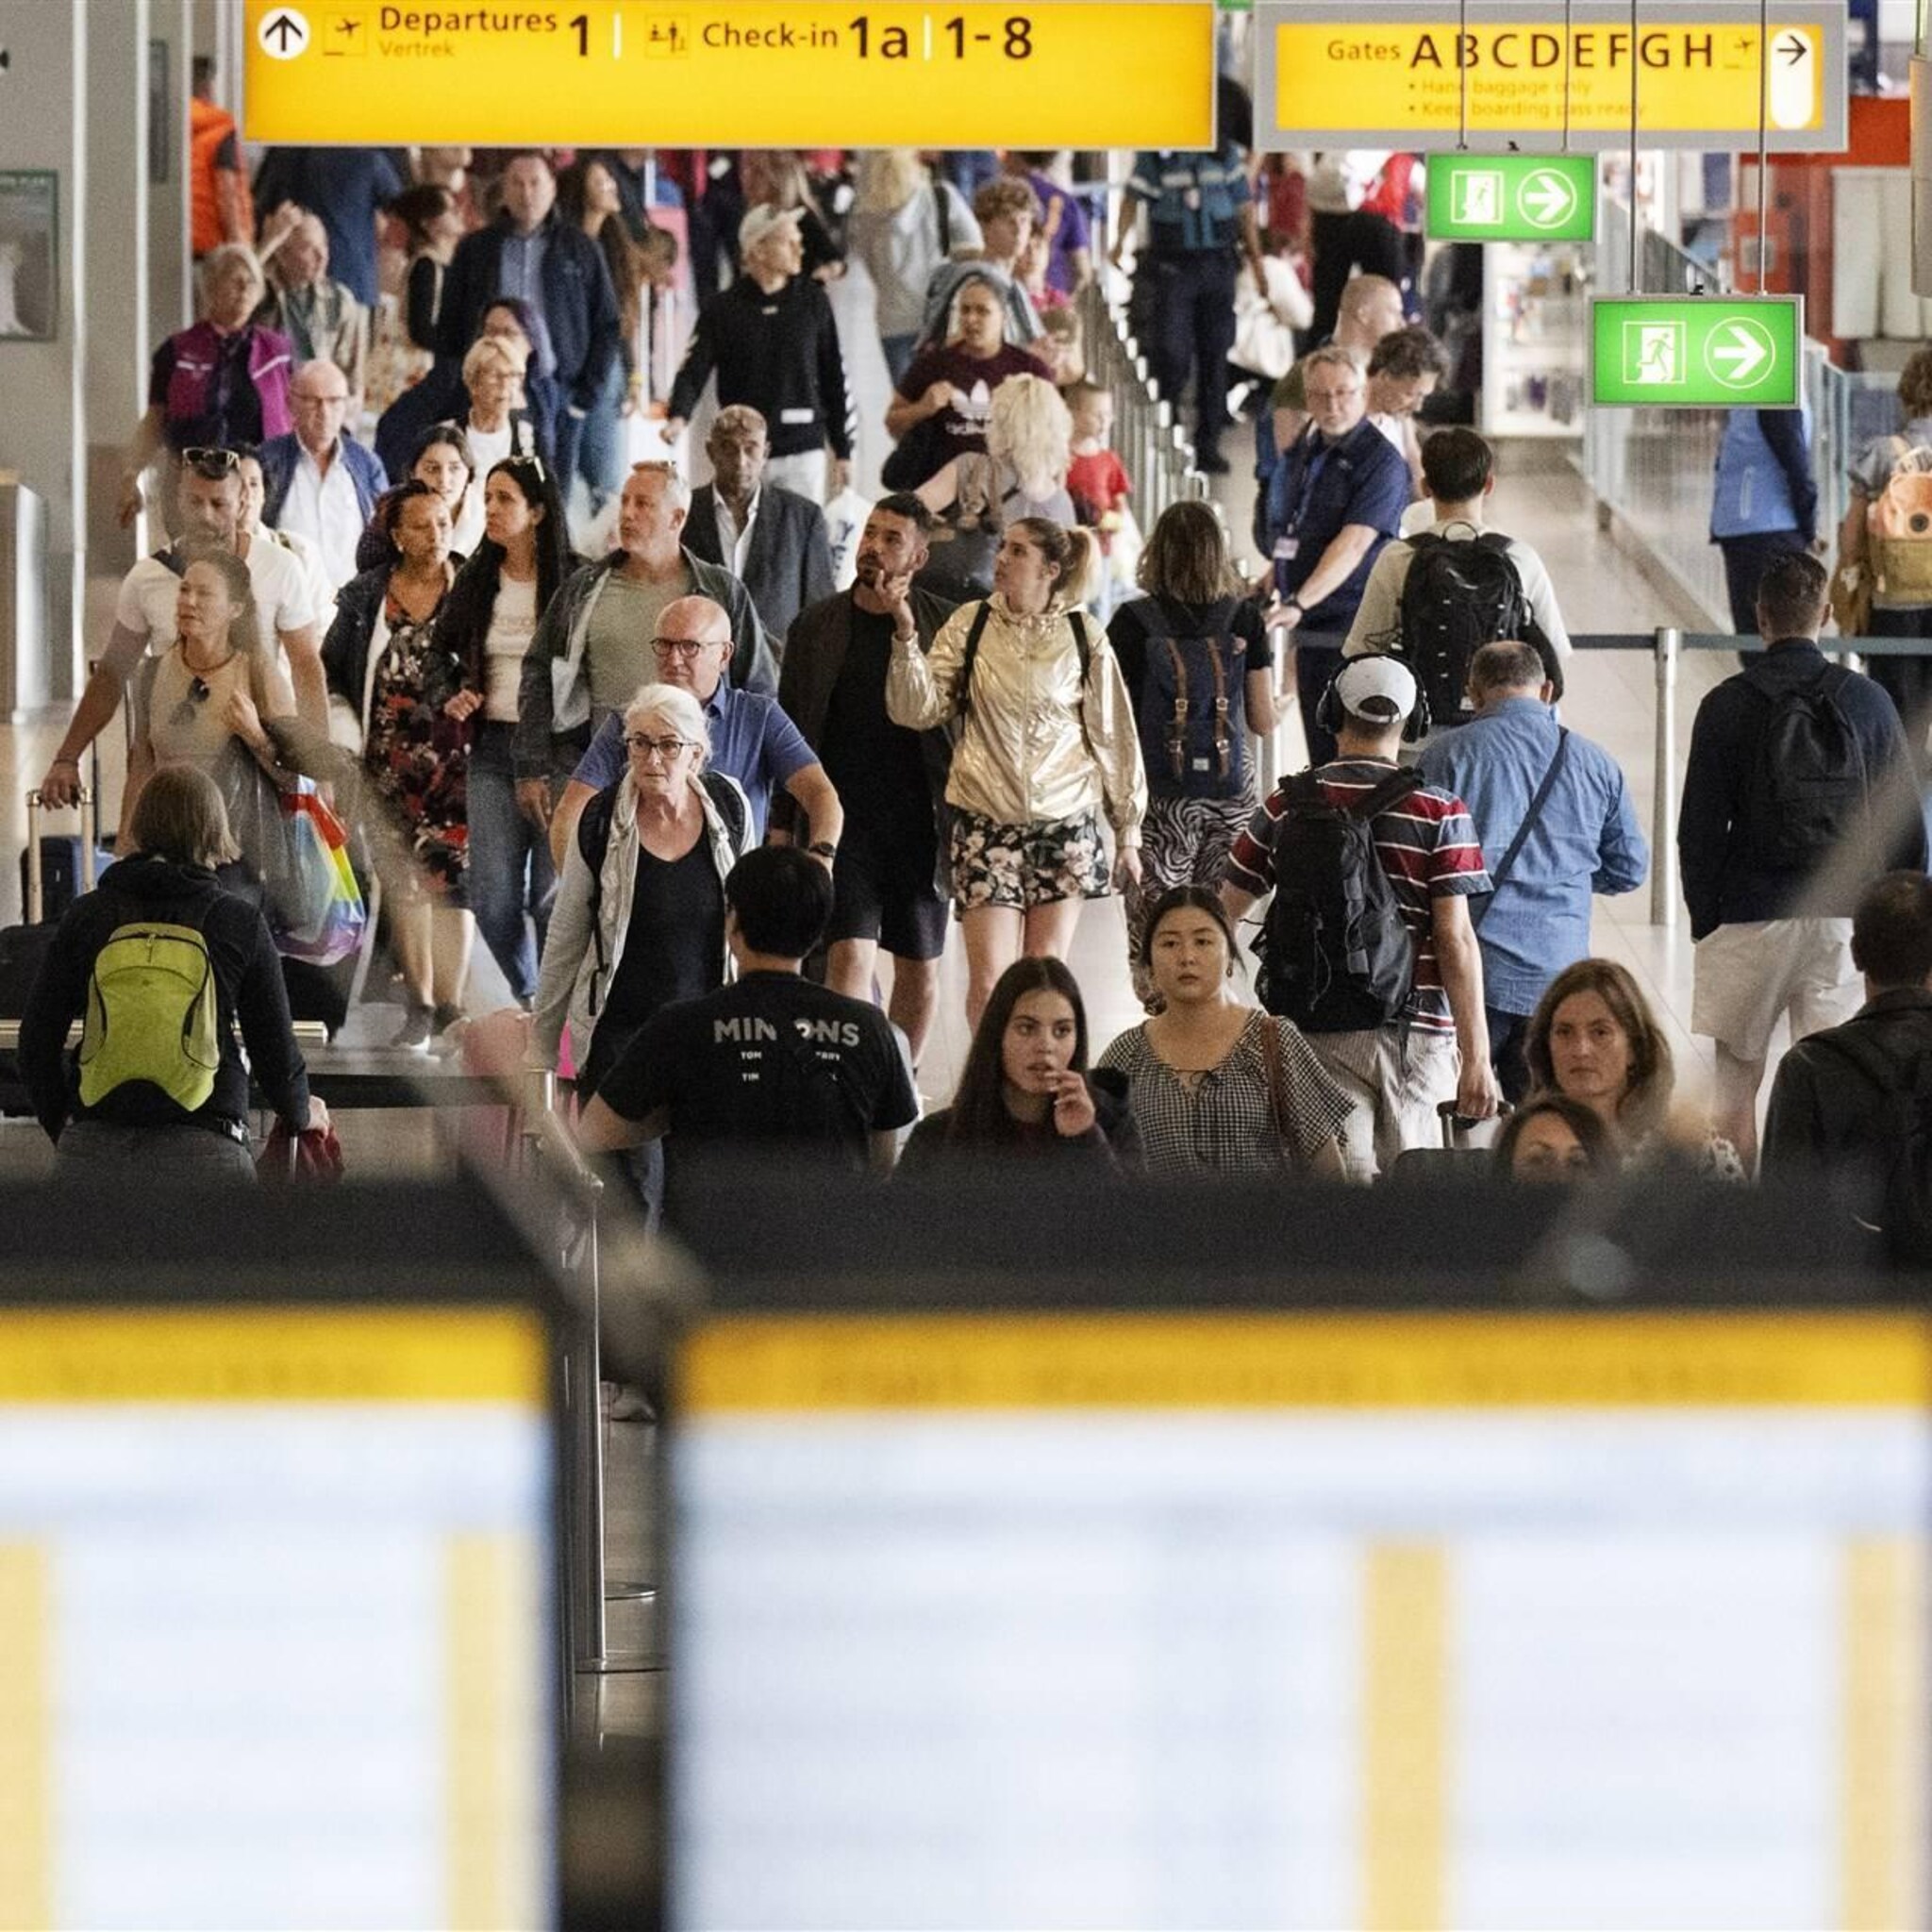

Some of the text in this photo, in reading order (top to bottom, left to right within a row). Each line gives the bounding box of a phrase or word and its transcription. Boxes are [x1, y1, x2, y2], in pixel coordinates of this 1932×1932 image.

[379, 6, 590, 58] Departures 1
[702, 15, 1033, 60] Check-in 1a 1-8
[379, 40, 455, 58] Vertrek
[1326, 39, 1402, 62] Gates
[1472, 79, 1549, 97] baggage
[1471, 102, 1550, 118] boarding
